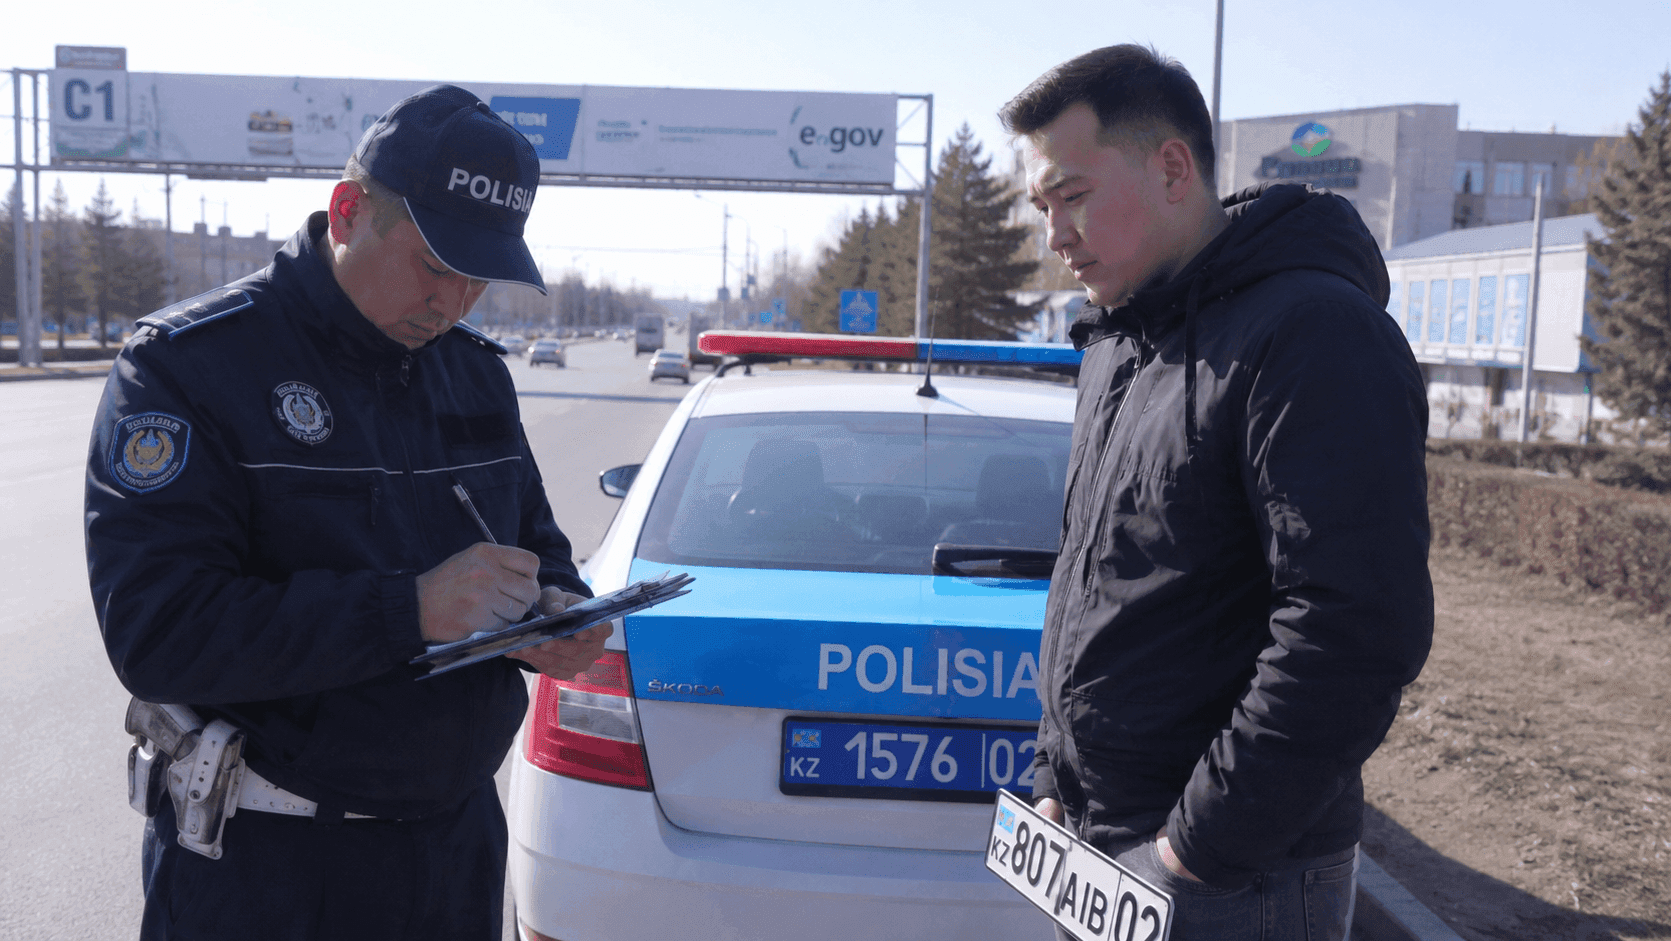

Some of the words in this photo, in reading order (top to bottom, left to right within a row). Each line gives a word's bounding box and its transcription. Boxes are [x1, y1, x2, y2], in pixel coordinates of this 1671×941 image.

[63, 77, 114, 122] C1
[647, 678, 724, 697] ŠKODA
[817, 643, 1041, 700] POLISIA
[790, 757, 820, 778] KZ
[844, 731, 958, 783] 1576
[988, 738, 1038, 787] 02
[990, 835, 1010, 867] KZ
[1011, 820, 1067, 899] 807
[1060, 871, 1108, 937] AIB
